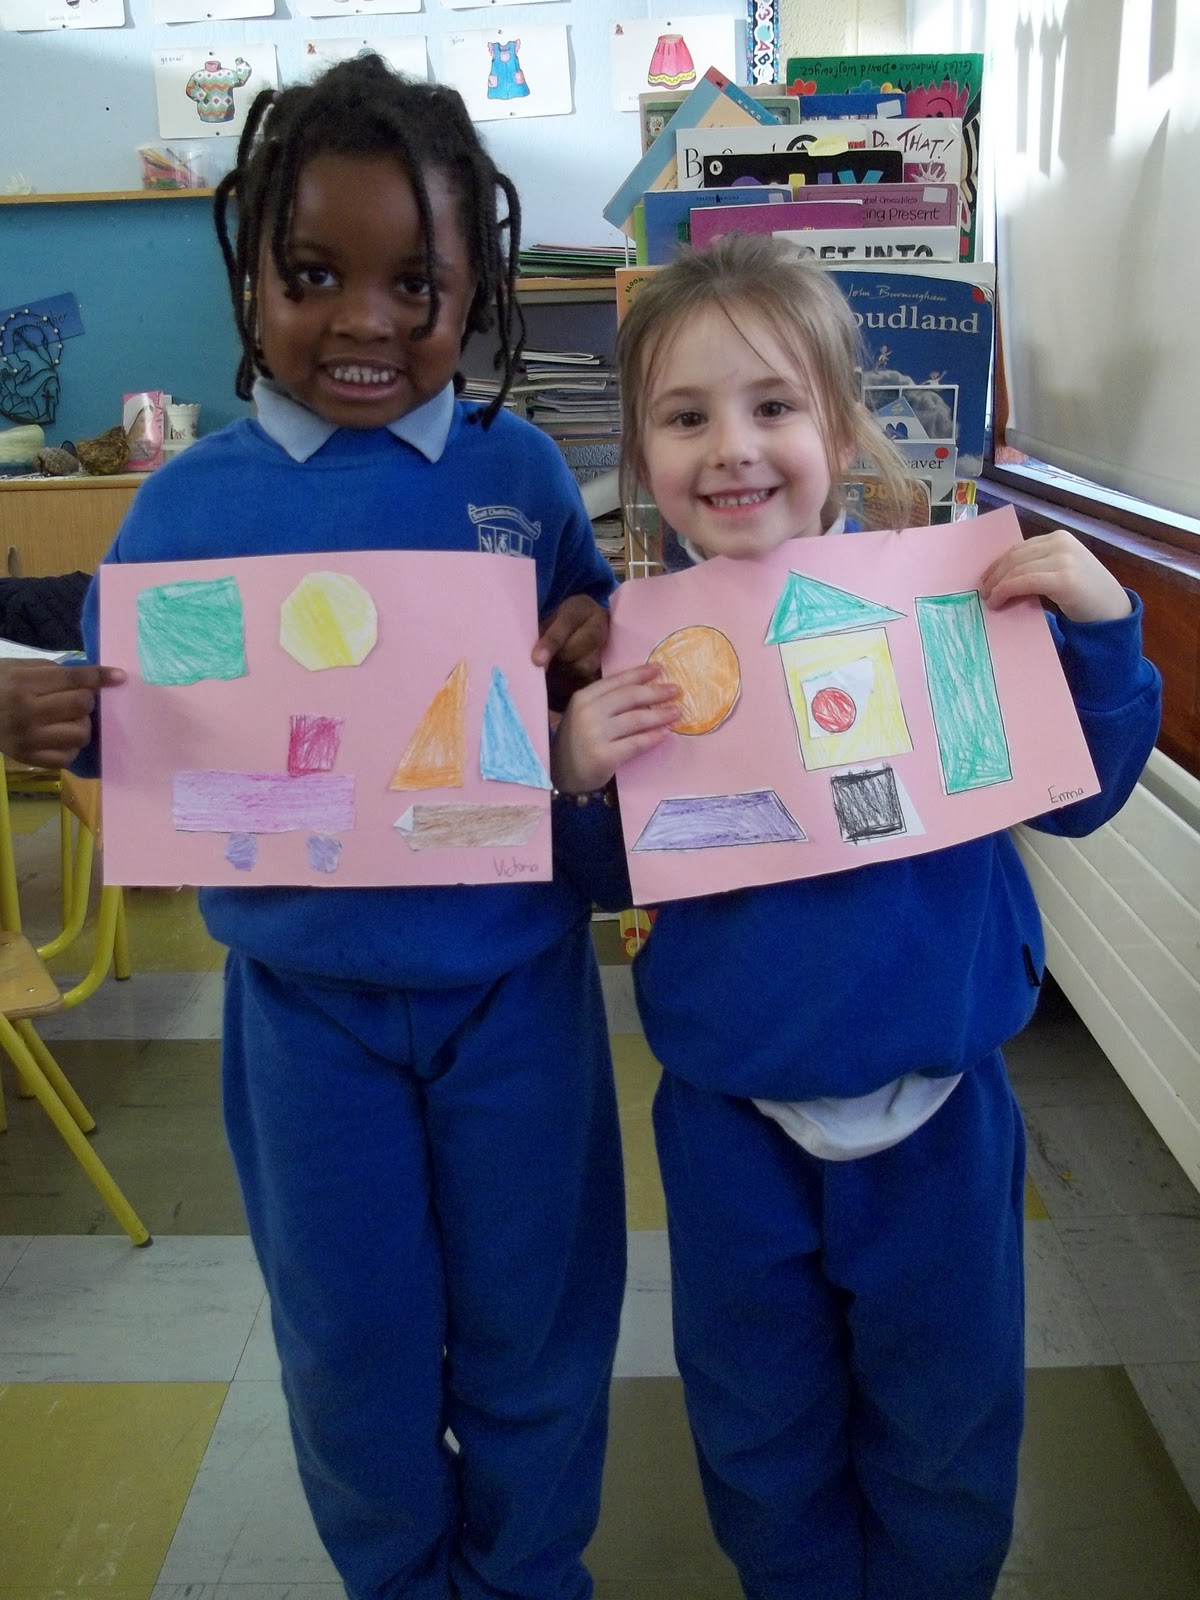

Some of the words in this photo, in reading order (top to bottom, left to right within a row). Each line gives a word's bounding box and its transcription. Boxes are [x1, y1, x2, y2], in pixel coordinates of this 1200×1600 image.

[860, 62, 891, 77] David
[944, 60, 972, 74] Giles
[897, 124, 955, 160] THAT!
[865, 244, 934, 259] INTO
[1047, 784, 1085, 804] Emma
